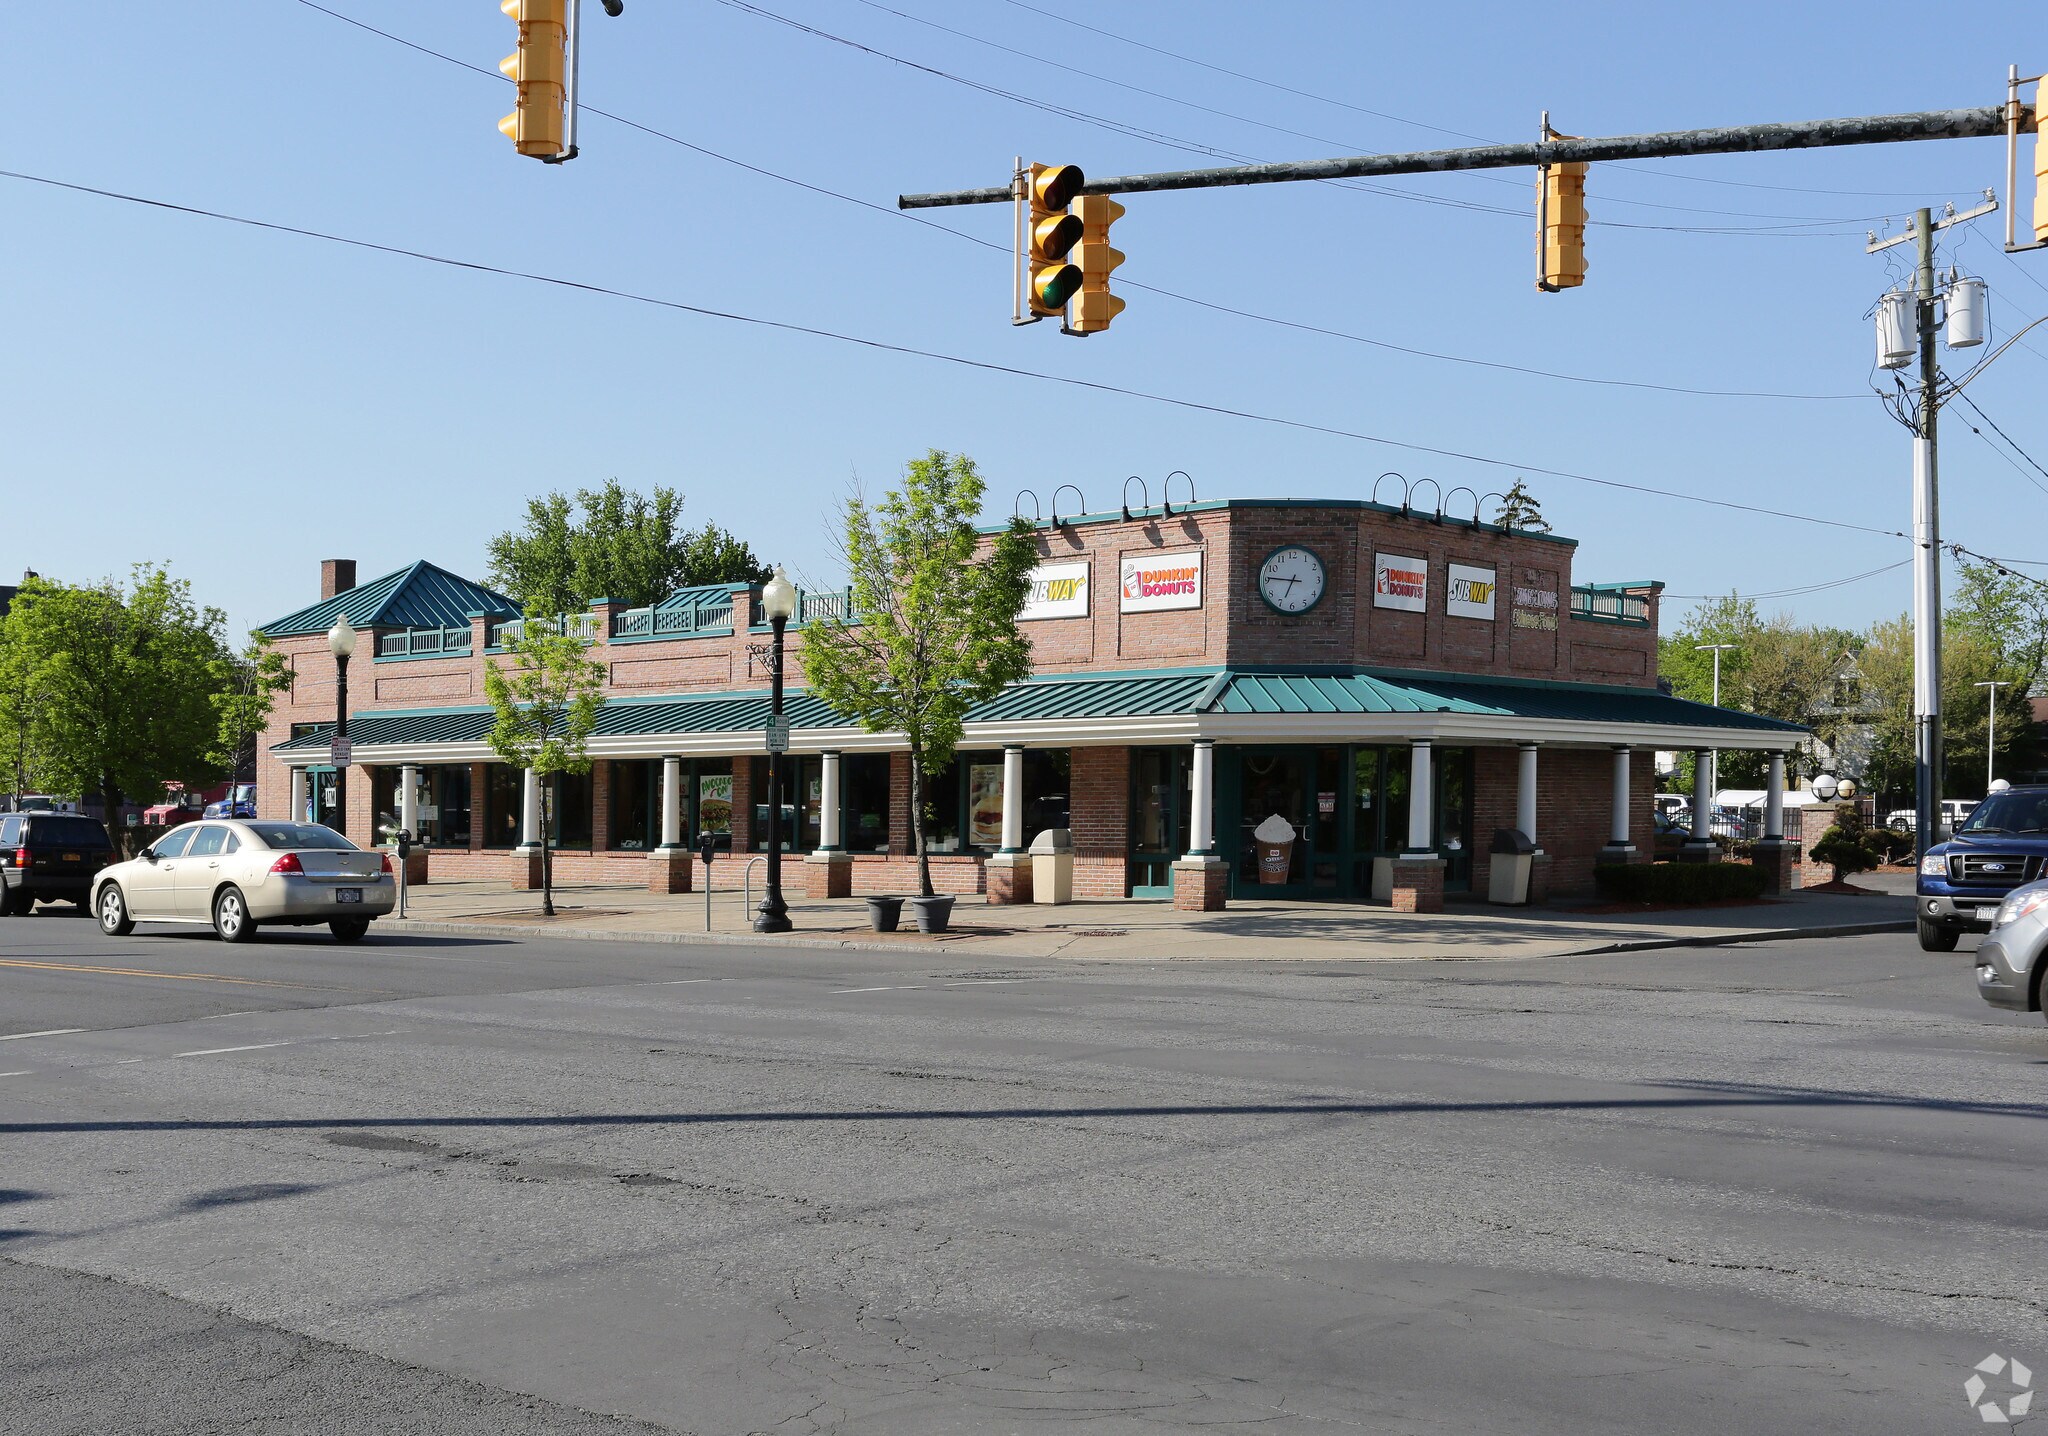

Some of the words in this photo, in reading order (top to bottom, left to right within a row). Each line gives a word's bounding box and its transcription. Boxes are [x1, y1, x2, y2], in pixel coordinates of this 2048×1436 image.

[1312, 563, 1317, 571] 2
[1143, 566, 1199, 583] DUNKIN'
[1265, 576, 1270, 584] 9
[1316, 576, 1320, 584] 3
[1390, 568, 1426, 585] DUNKIN'
[1029, 575, 1087, 603] UBWAY
[1142, 581, 1196, 598] DONUTS
[1389, 581, 1424, 599] DONUTS
[1449, 577, 1495, 605] SUBWAY
[1278, 599, 1283, 607] 7
[1302, 599, 1307, 607] 5
[769, 717, 775, 726] 4
